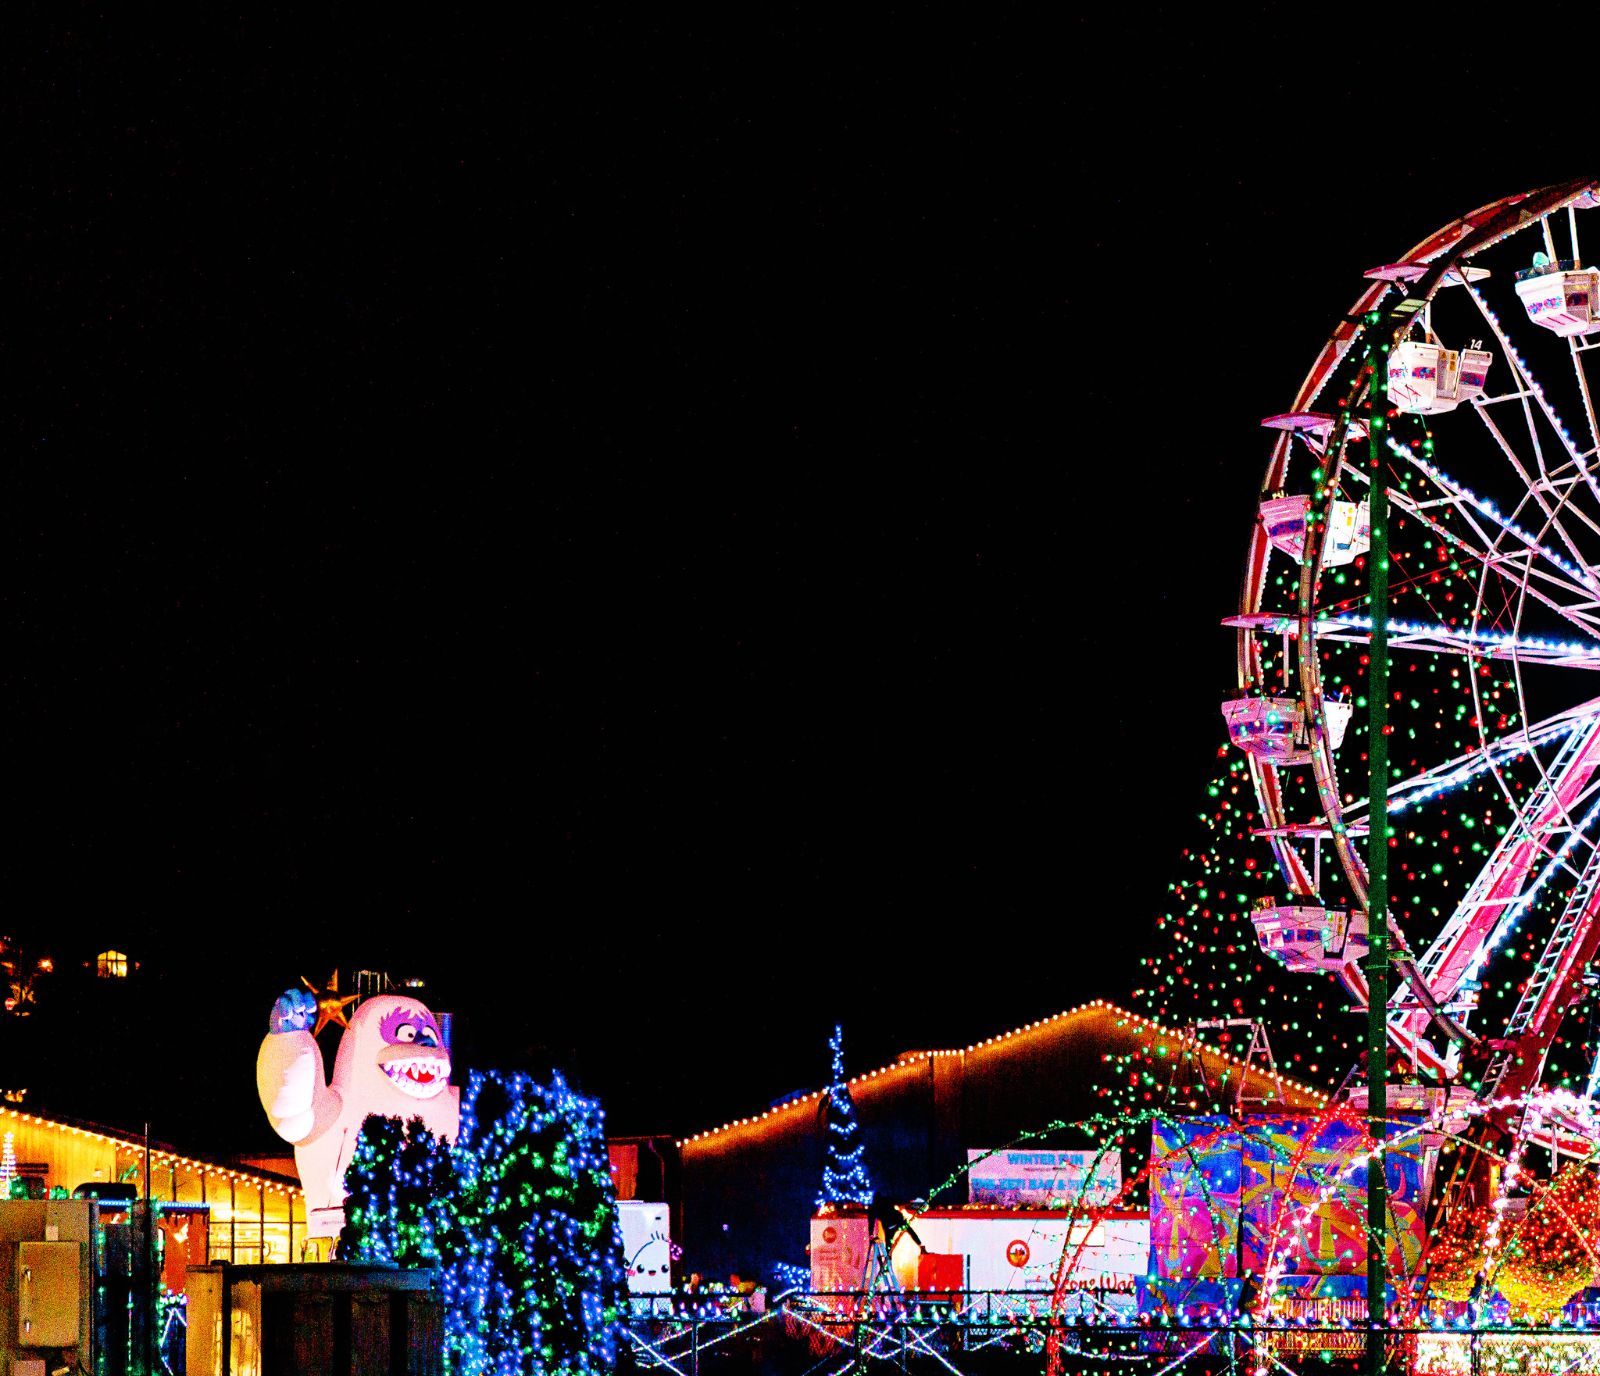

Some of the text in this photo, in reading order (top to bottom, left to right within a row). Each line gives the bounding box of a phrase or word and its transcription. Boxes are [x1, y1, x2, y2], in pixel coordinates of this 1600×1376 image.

[1470, 339, 1483, 350] 14
[1007, 1153, 1056, 1165] WINTER
[1049, 1271, 1096, 1291] Sone
